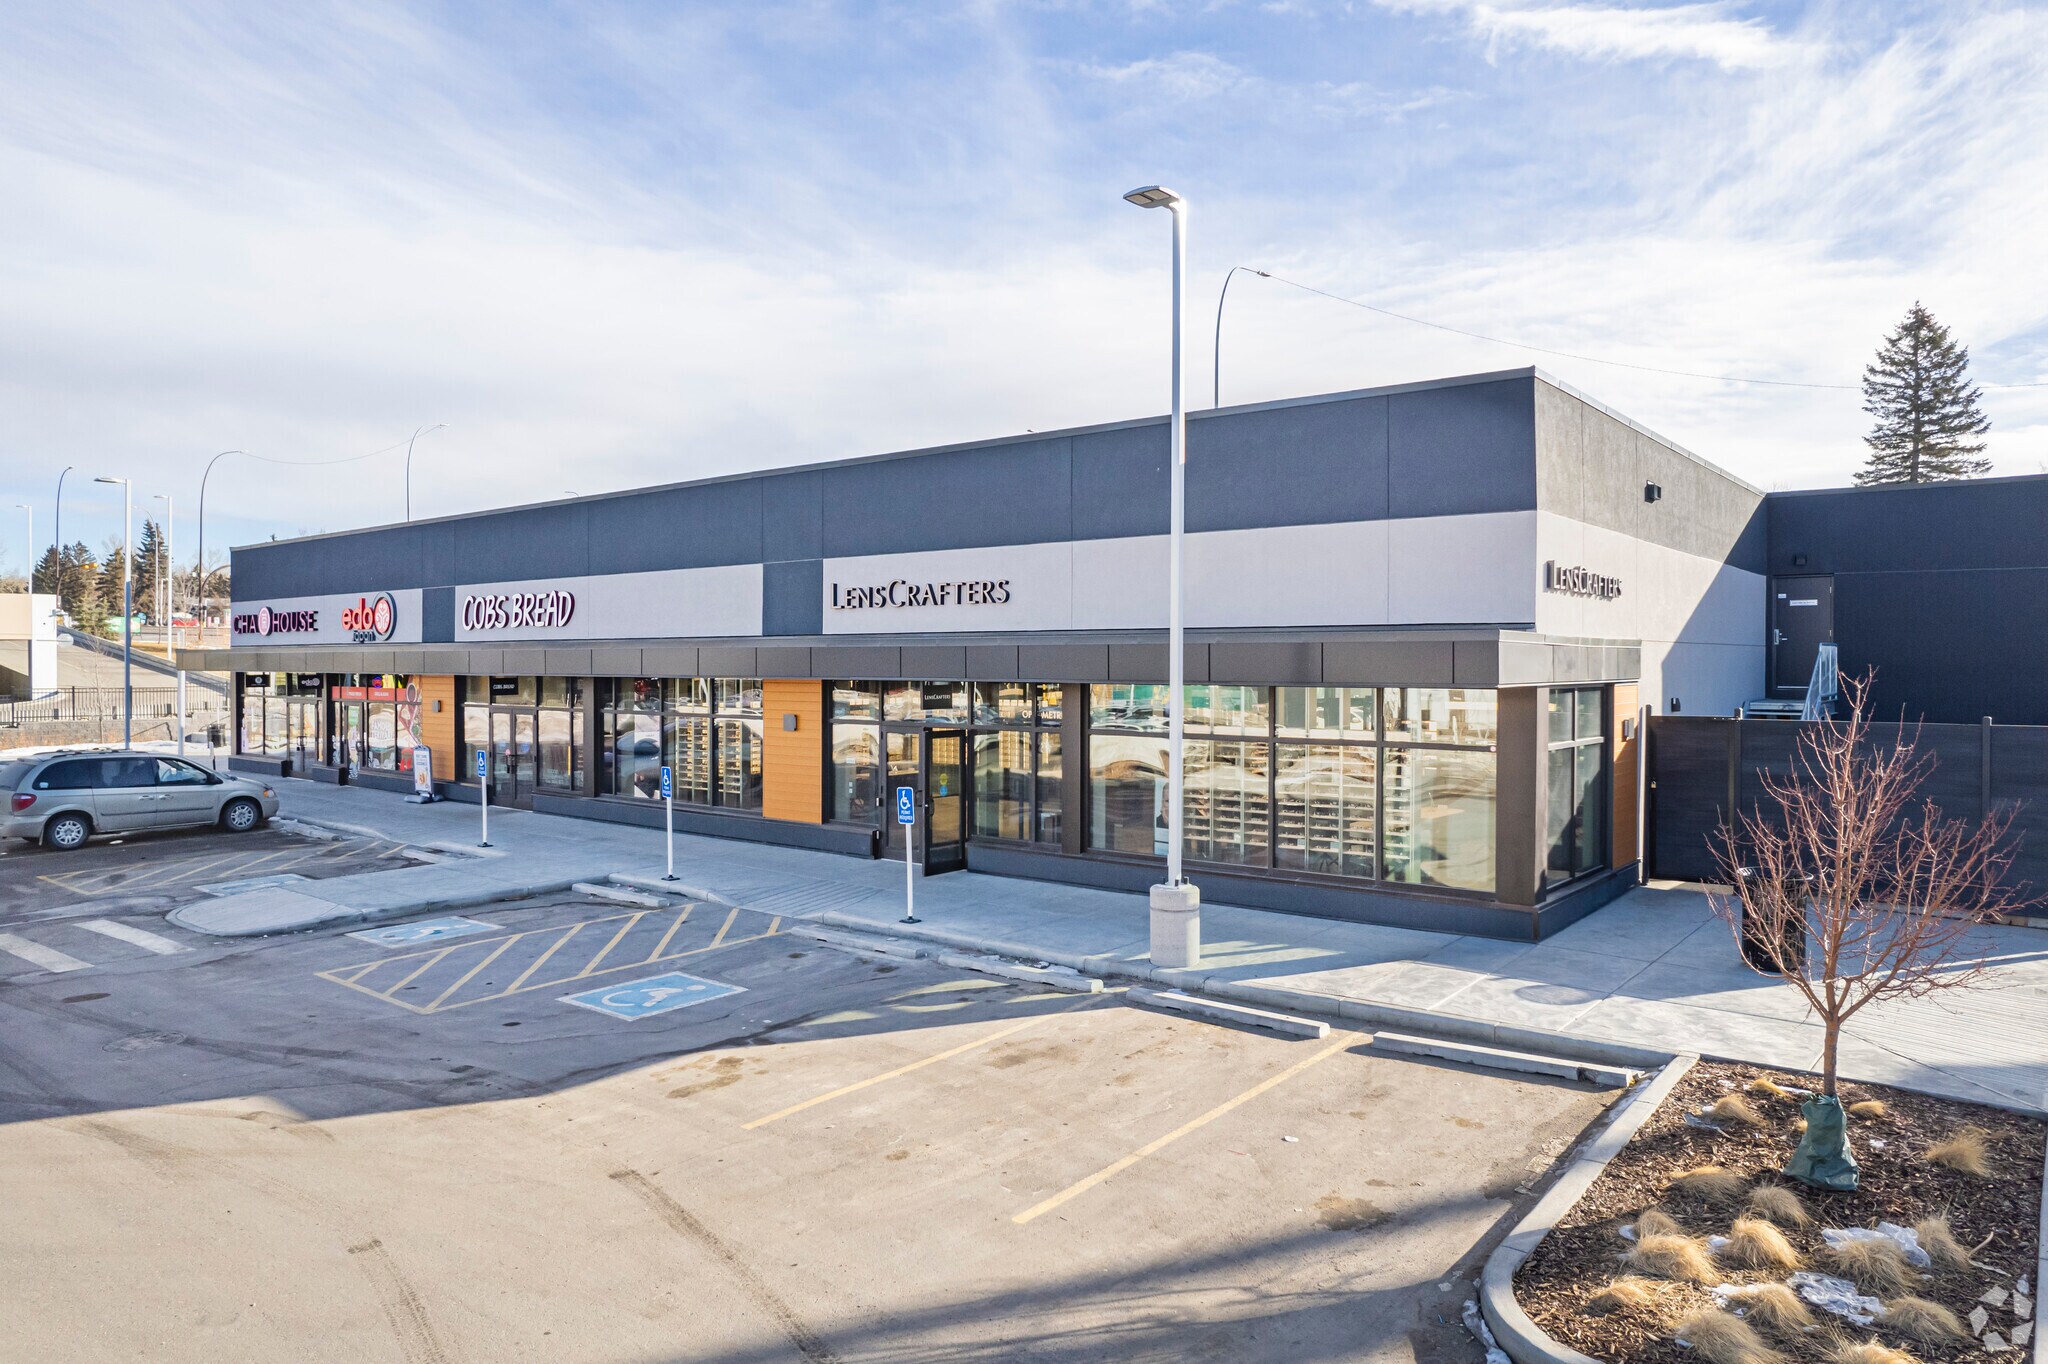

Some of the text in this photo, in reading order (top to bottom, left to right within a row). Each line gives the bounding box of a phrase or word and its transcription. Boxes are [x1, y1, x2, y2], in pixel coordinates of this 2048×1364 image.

[831, 579, 1011, 609] LENSCRAFTERS
[233, 611, 318, 634] CHA HOUSE
[342, 598, 374, 631] edo
[462, 590, 575, 631] COBS BREAD
